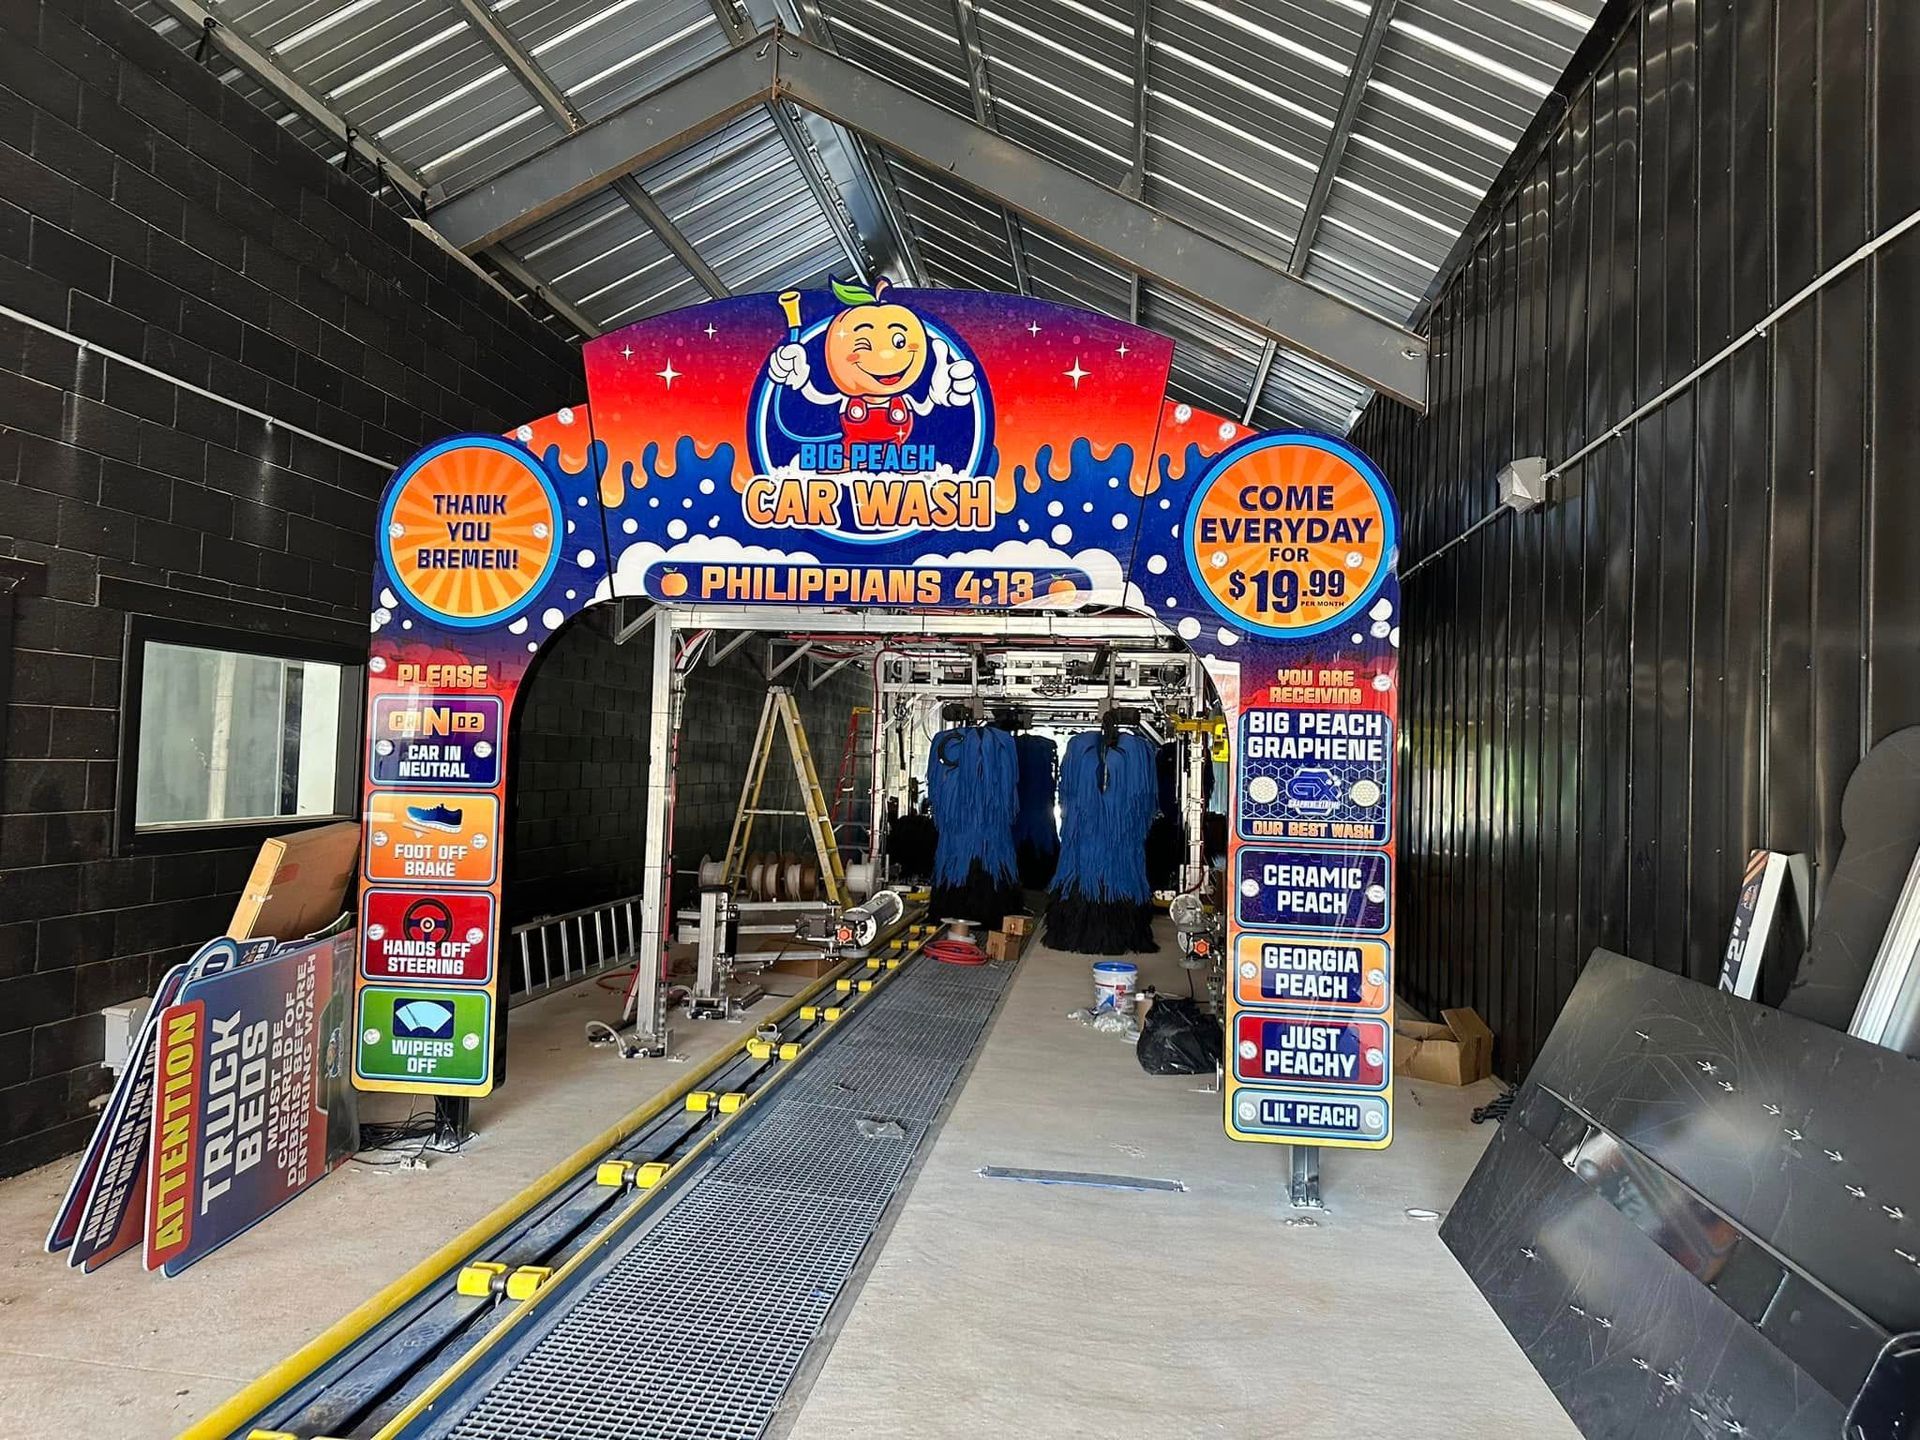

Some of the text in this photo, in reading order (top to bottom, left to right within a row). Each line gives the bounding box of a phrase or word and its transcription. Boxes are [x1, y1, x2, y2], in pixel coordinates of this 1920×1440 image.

[800, 443, 936, 472] BIG PEACH
[433, 494, 508, 515] THANK
[746, 478, 993, 528] CAR WASH
[1239, 485, 1334, 512] COME
[447, 521, 491, 542] YOU
[1200, 518, 1373, 544] EVERYDAY
[417, 548, 519, 570] BREMEN!
[1269, 547, 1309, 563] FOR
[701, 566, 1034, 606] PHILIPPIANS 4:13
[397, 663, 488, 689] PLEASE
[1277, 669, 1355, 687] YOU ARE
[1269, 686, 1362, 705] RECEIVING
[1249, 711, 1382, 737] BIG PEACH
[408, 745, 461, 761] CAR IN
[1247, 736, 1382, 762] GRAPHENE
[398, 761, 470, 779] NEUTRAL
[1252, 820, 1375, 839] OUR BEST WASH
[393, 844, 469, 861] FOOT OFF
[404, 861, 456, 877] BRAKE
[1263, 864, 1363, 890] CERAMIC
[1277, 889, 1348, 915] PEACH
[383, 939, 472, 958] HANDS OFF
[1263, 946, 1360, 974] GEORGIA
[387, 957, 465, 975] STEERING
[1275, 972, 1348, 999] PEACH
[391, 1039, 454, 1057] WIPERS
[1280, 1025, 1341, 1052] JUST
[287, 961, 308, 1187] DEBRIS BEFORE
[298, 953, 317, 1186] ENTERING WASH
[406, 1057, 437, 1074] OFF
[1264, 1049, 1357, 1078] PEACHY
[267, 1018, 284, 1151] MUST BE
[278, 991, 296, 1169] CLEARED OF
[125, 1078, 151, 1120] THE
[235, 1019, 269, 1176] BEDS
[201, 1010, 241, 1216] TRUCK
[1262, 1101, 1358, 1128] LIL' PEACH
[116, 1120, 136, 1145] IN
[155, 1011, 197, 1251] ATTENTION
[94, 1183, 128, 1250] THREE
[116, 1121, 150, 1187] WASH
